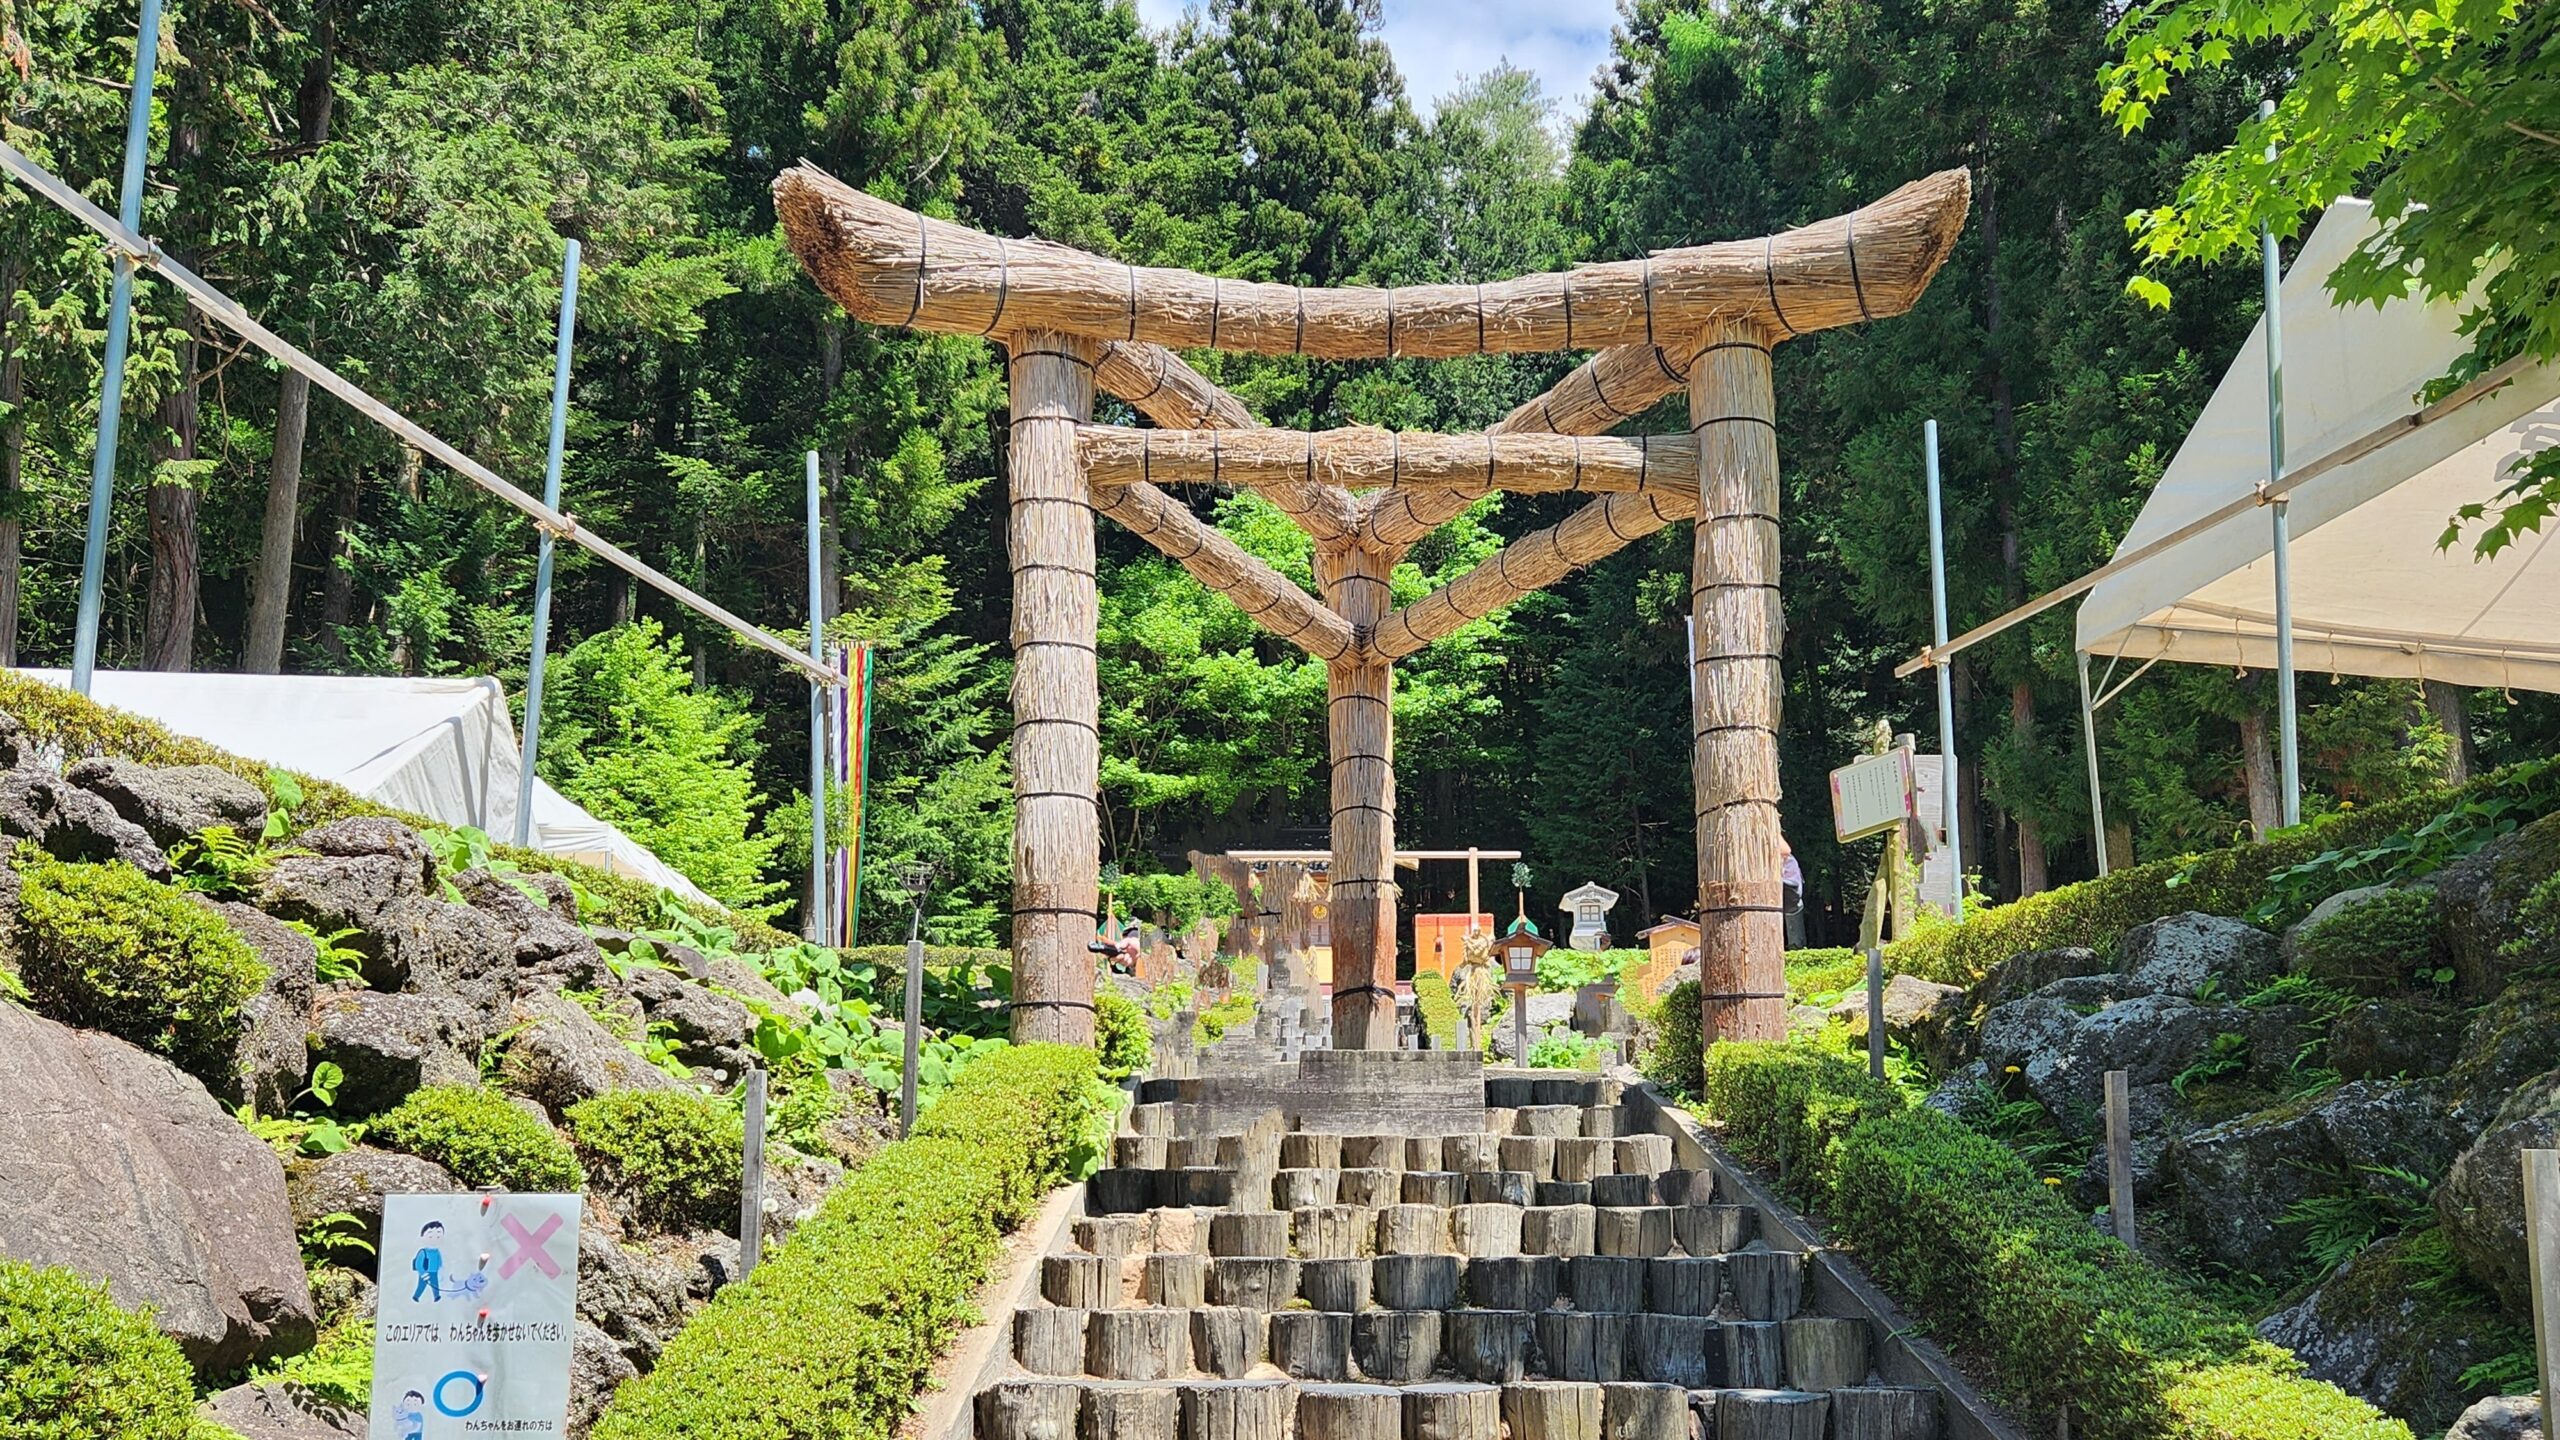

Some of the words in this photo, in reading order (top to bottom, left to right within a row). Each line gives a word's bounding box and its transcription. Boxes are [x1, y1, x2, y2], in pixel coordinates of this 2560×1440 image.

[465, 1419, 552, 1432] わんちゃんをお連れの方は
